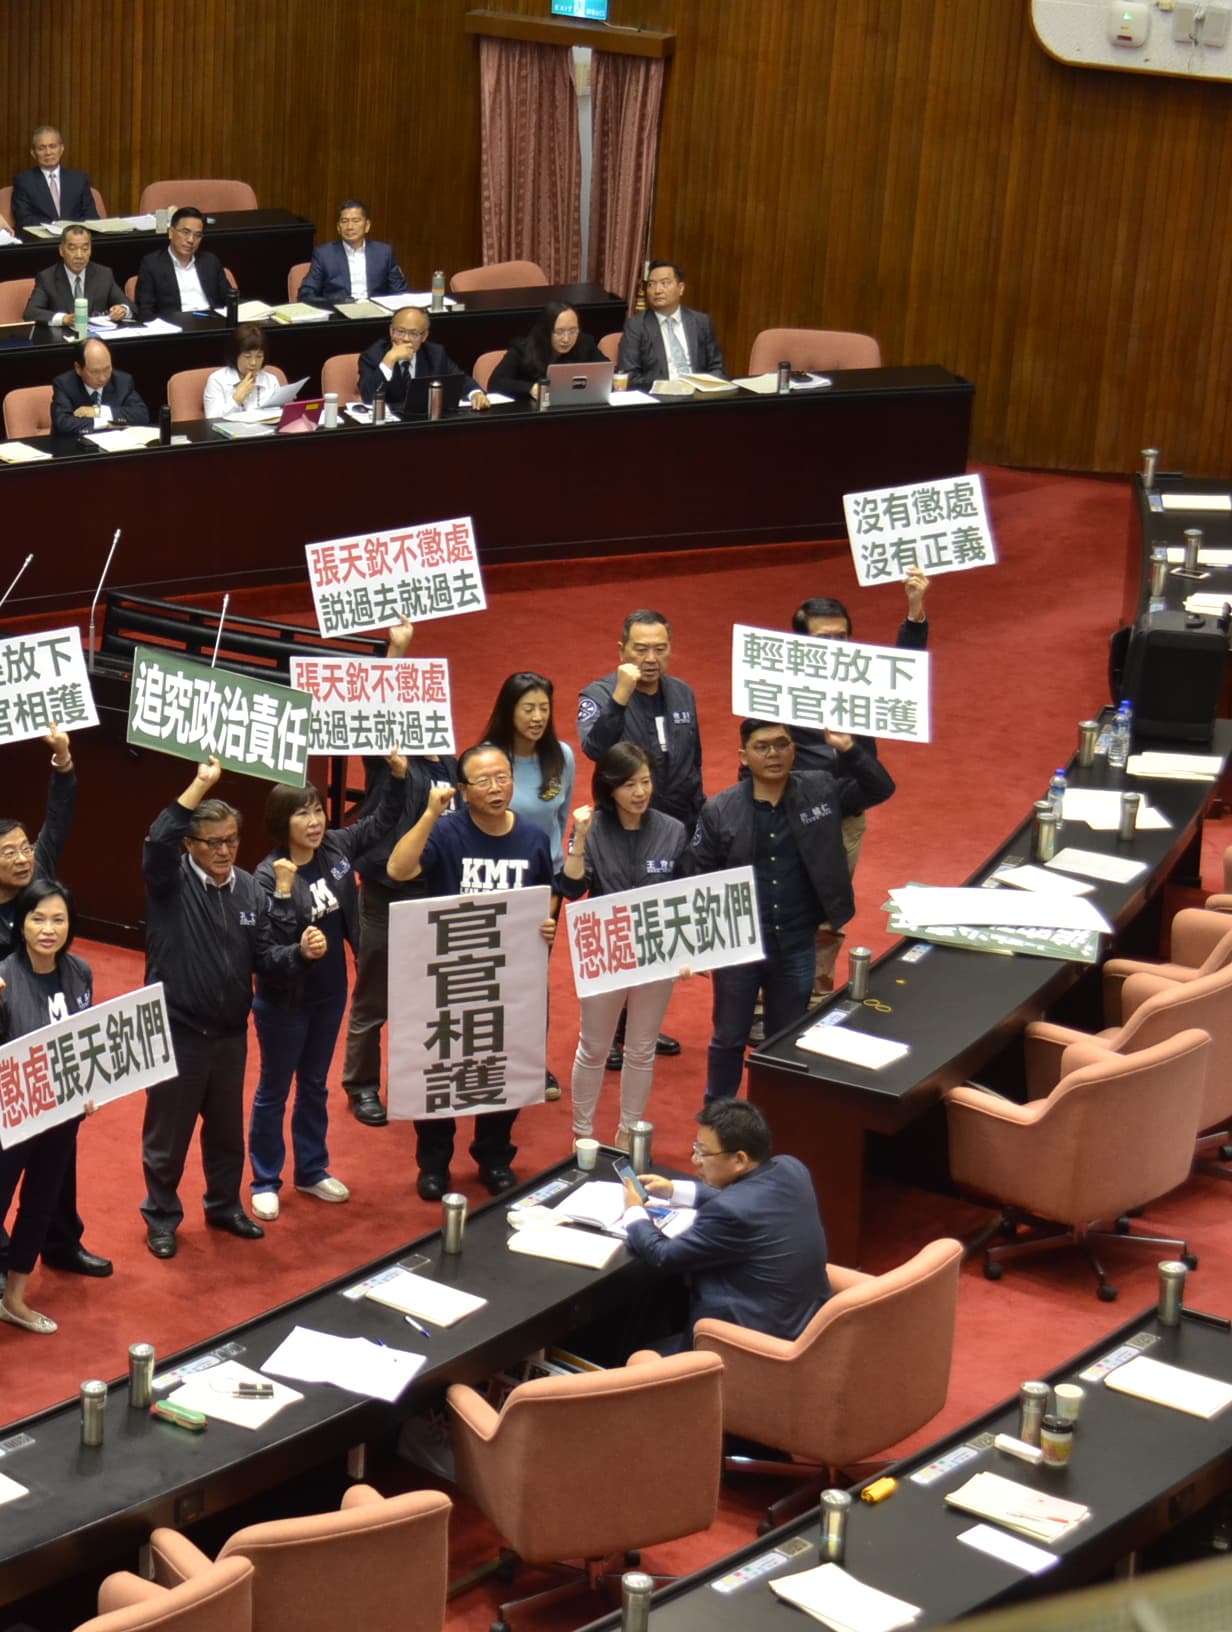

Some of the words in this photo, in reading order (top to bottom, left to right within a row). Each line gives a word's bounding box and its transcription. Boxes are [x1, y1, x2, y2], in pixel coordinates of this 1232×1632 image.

[853, 481, 979, 535] 沒有懲處
[311, 523, 474, 588] 張天欽不懲處
[861, 526, 987, 579] 沒有正義
[295, 662, 448, 704] 張天欽不懲處
[742, 632, 916, 690] 輕輕放下
[132, 661, 309, 774] 追究政治責任
[743, 679, 918, 736] 官官相護
[460, 858, 530, 889] KMT
[572, 881, 757, 980] 懲處張天欽們
[423, 901, 508, 1114] 官官相護
